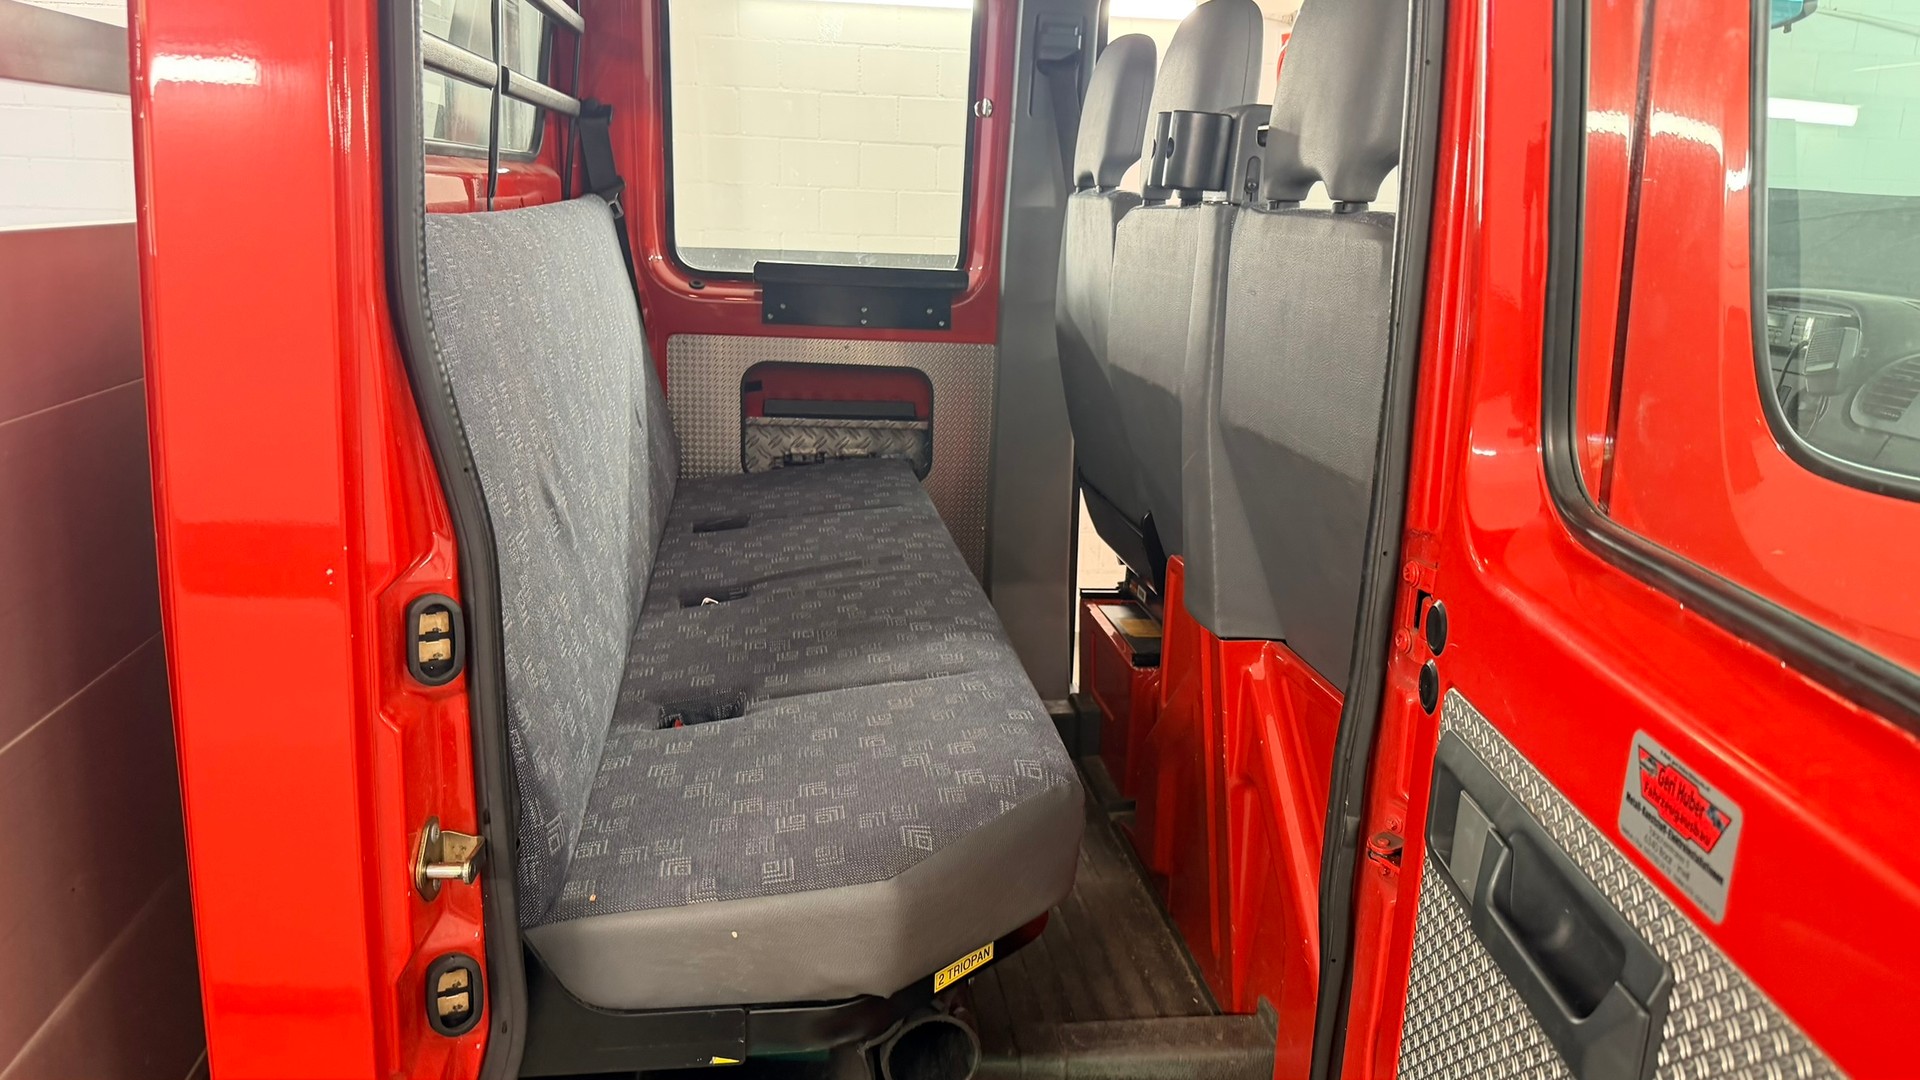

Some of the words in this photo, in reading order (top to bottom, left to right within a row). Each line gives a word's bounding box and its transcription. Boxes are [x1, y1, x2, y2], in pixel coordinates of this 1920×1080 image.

[1657, 768, 1678, 797] Geri
[1677, 781, 1705, 820] Huber
[938, 973, 945, 986] 2
[947, 946, 991, 979] TRIOPAN
